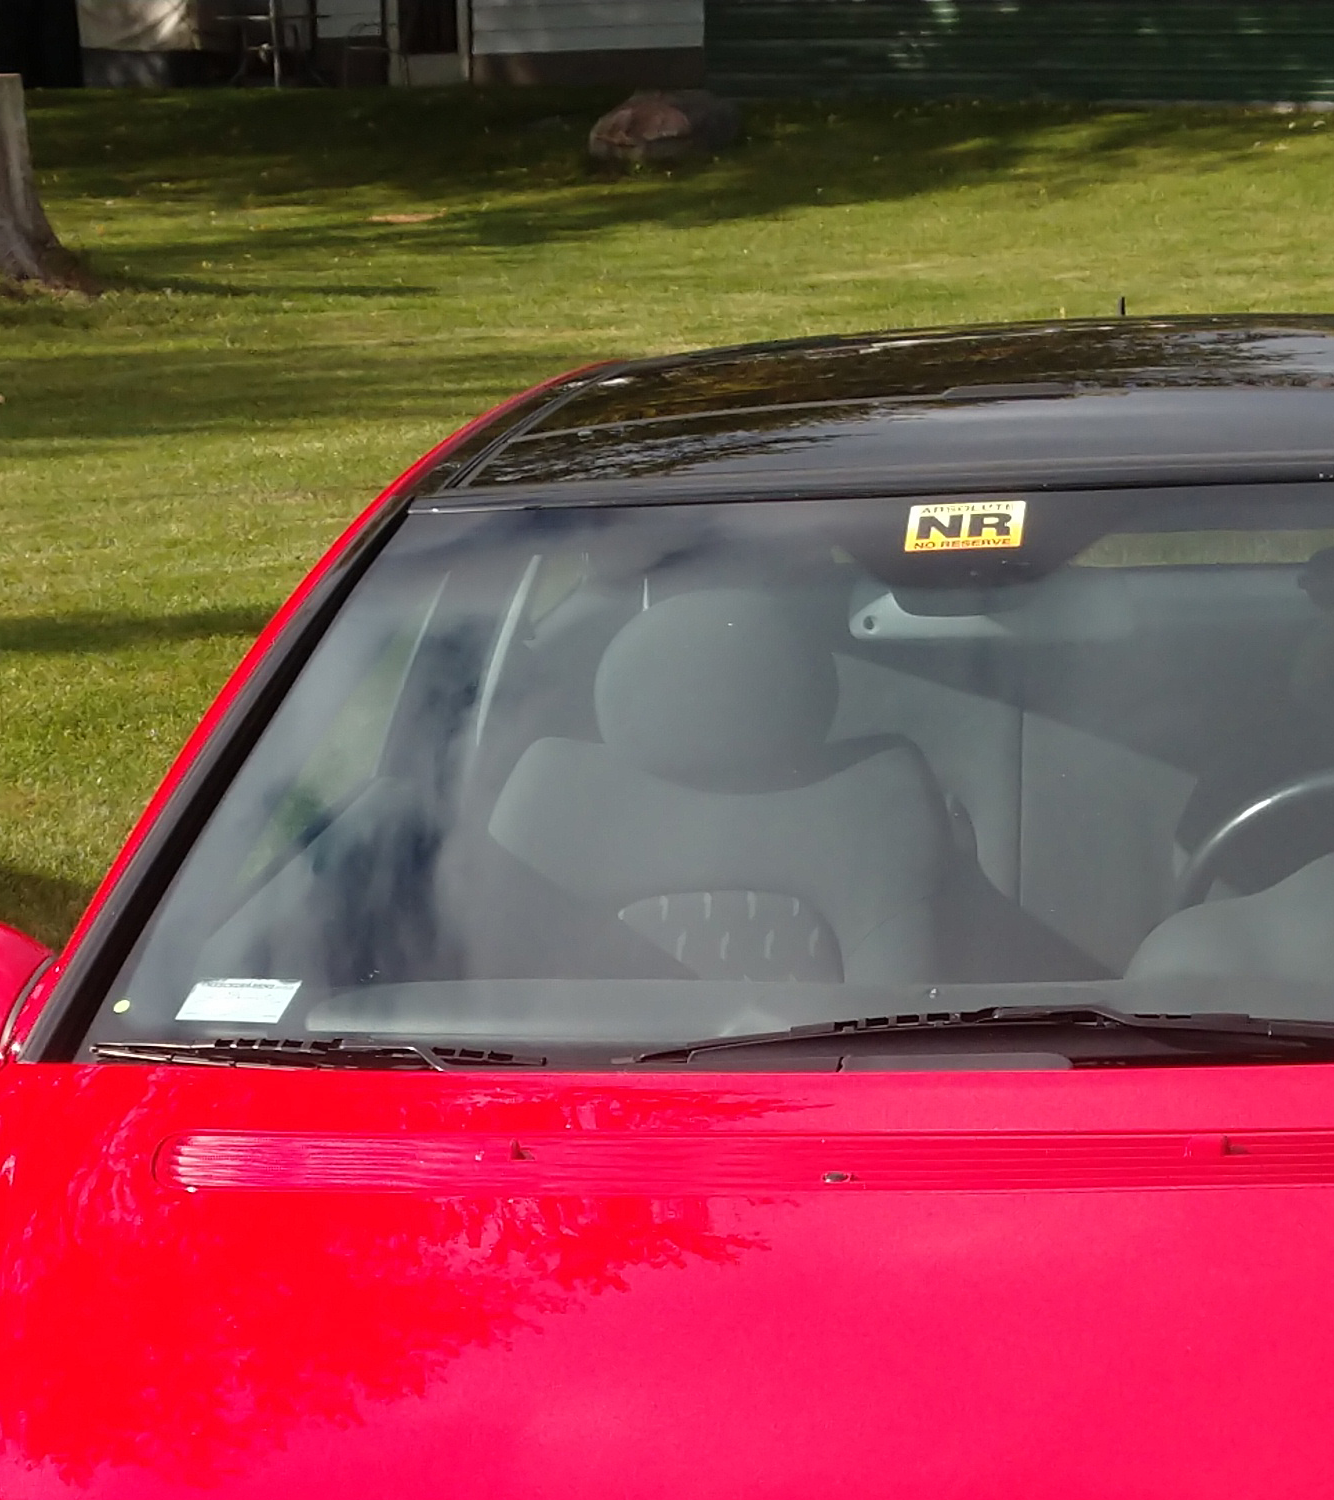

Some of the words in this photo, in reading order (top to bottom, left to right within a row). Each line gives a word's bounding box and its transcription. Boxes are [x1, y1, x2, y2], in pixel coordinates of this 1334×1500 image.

[915, 513, 1012, 540] NR
[914, 541, 936, 549] NO
[940, 538, 1011, 548] RESERVE
